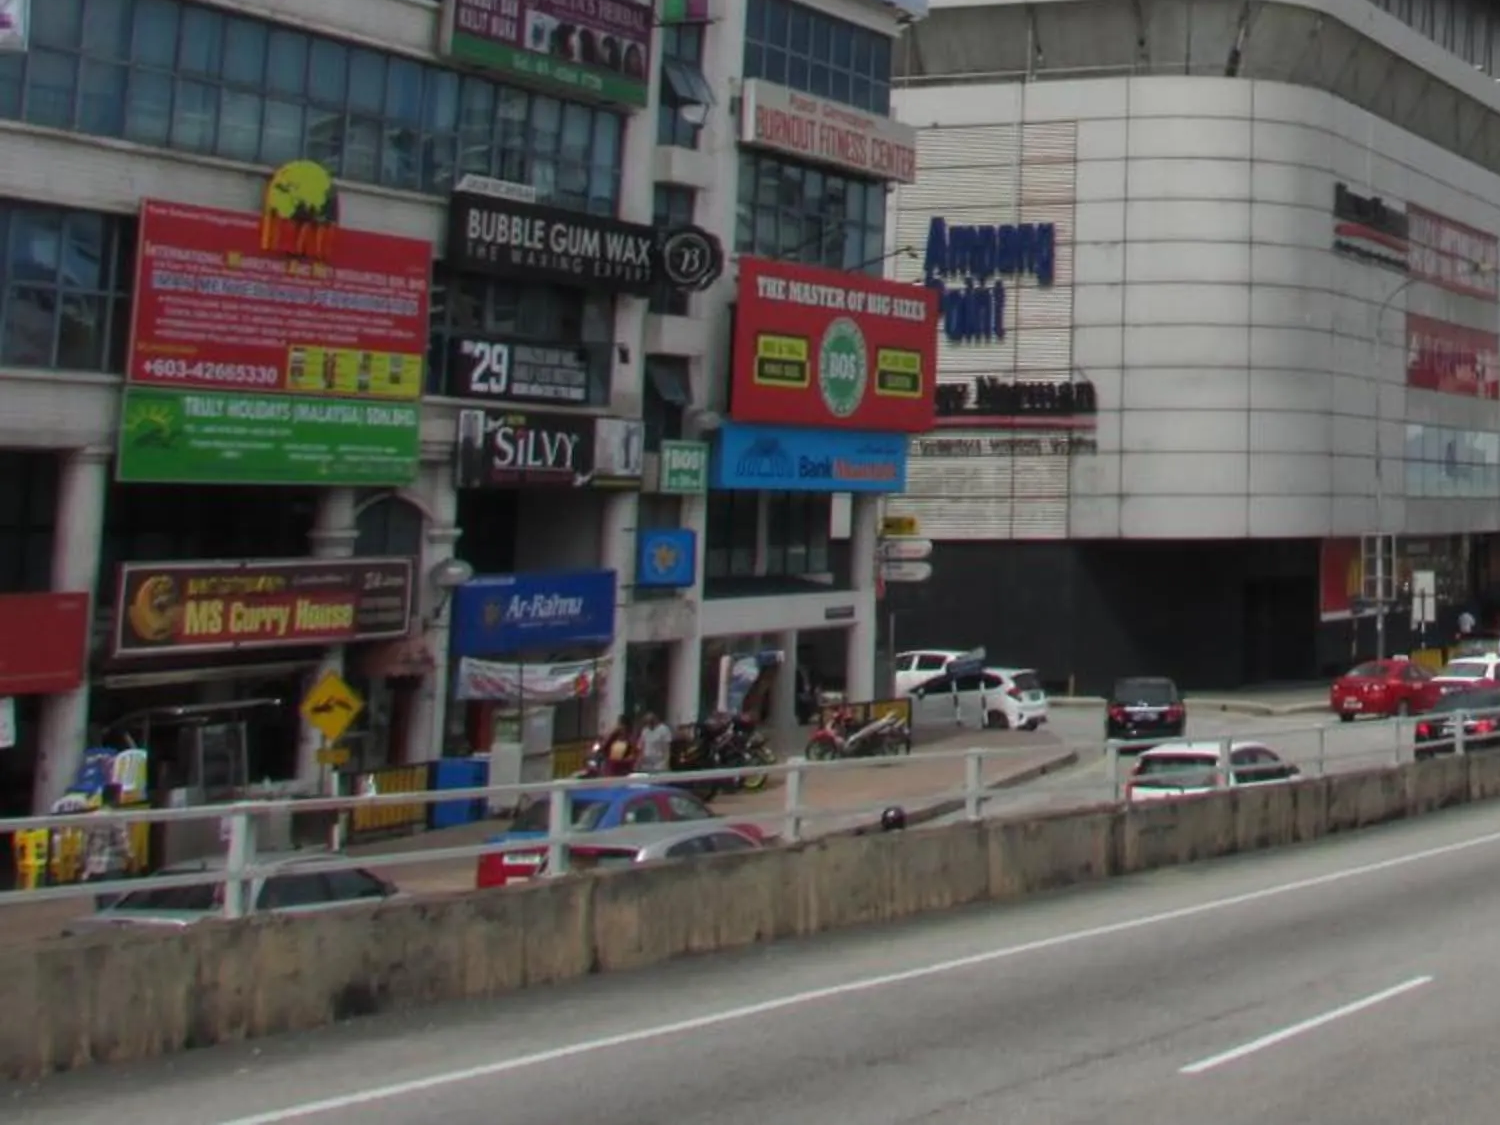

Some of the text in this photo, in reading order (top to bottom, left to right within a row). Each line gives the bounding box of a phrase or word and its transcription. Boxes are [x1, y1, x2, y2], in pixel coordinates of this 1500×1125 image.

[757, 105, 816, 154] BURNOUT
[818, 123, 868, 166] FITNESS
[870, 137, 916, 183] CENTER
[465, 241, 498, 262] THE
[467, 208, 652, 266] BUBBLE GUM WAX
[924, 216, 1055, 290] Ampang
[757, 275, 786, 300] THE
[789, 280, 845, 309] MASTER
[847, 289, 864, 312] OF
[892, 297, 926, 321] SIZES
[470, 341, 509, 394] 29
[184, 599, 225, 636] MS
[229, 601, 290, 636] Curry
[294, 598, 354, 630] House
[506, 593, 584, 619] Ar-Rahnu
